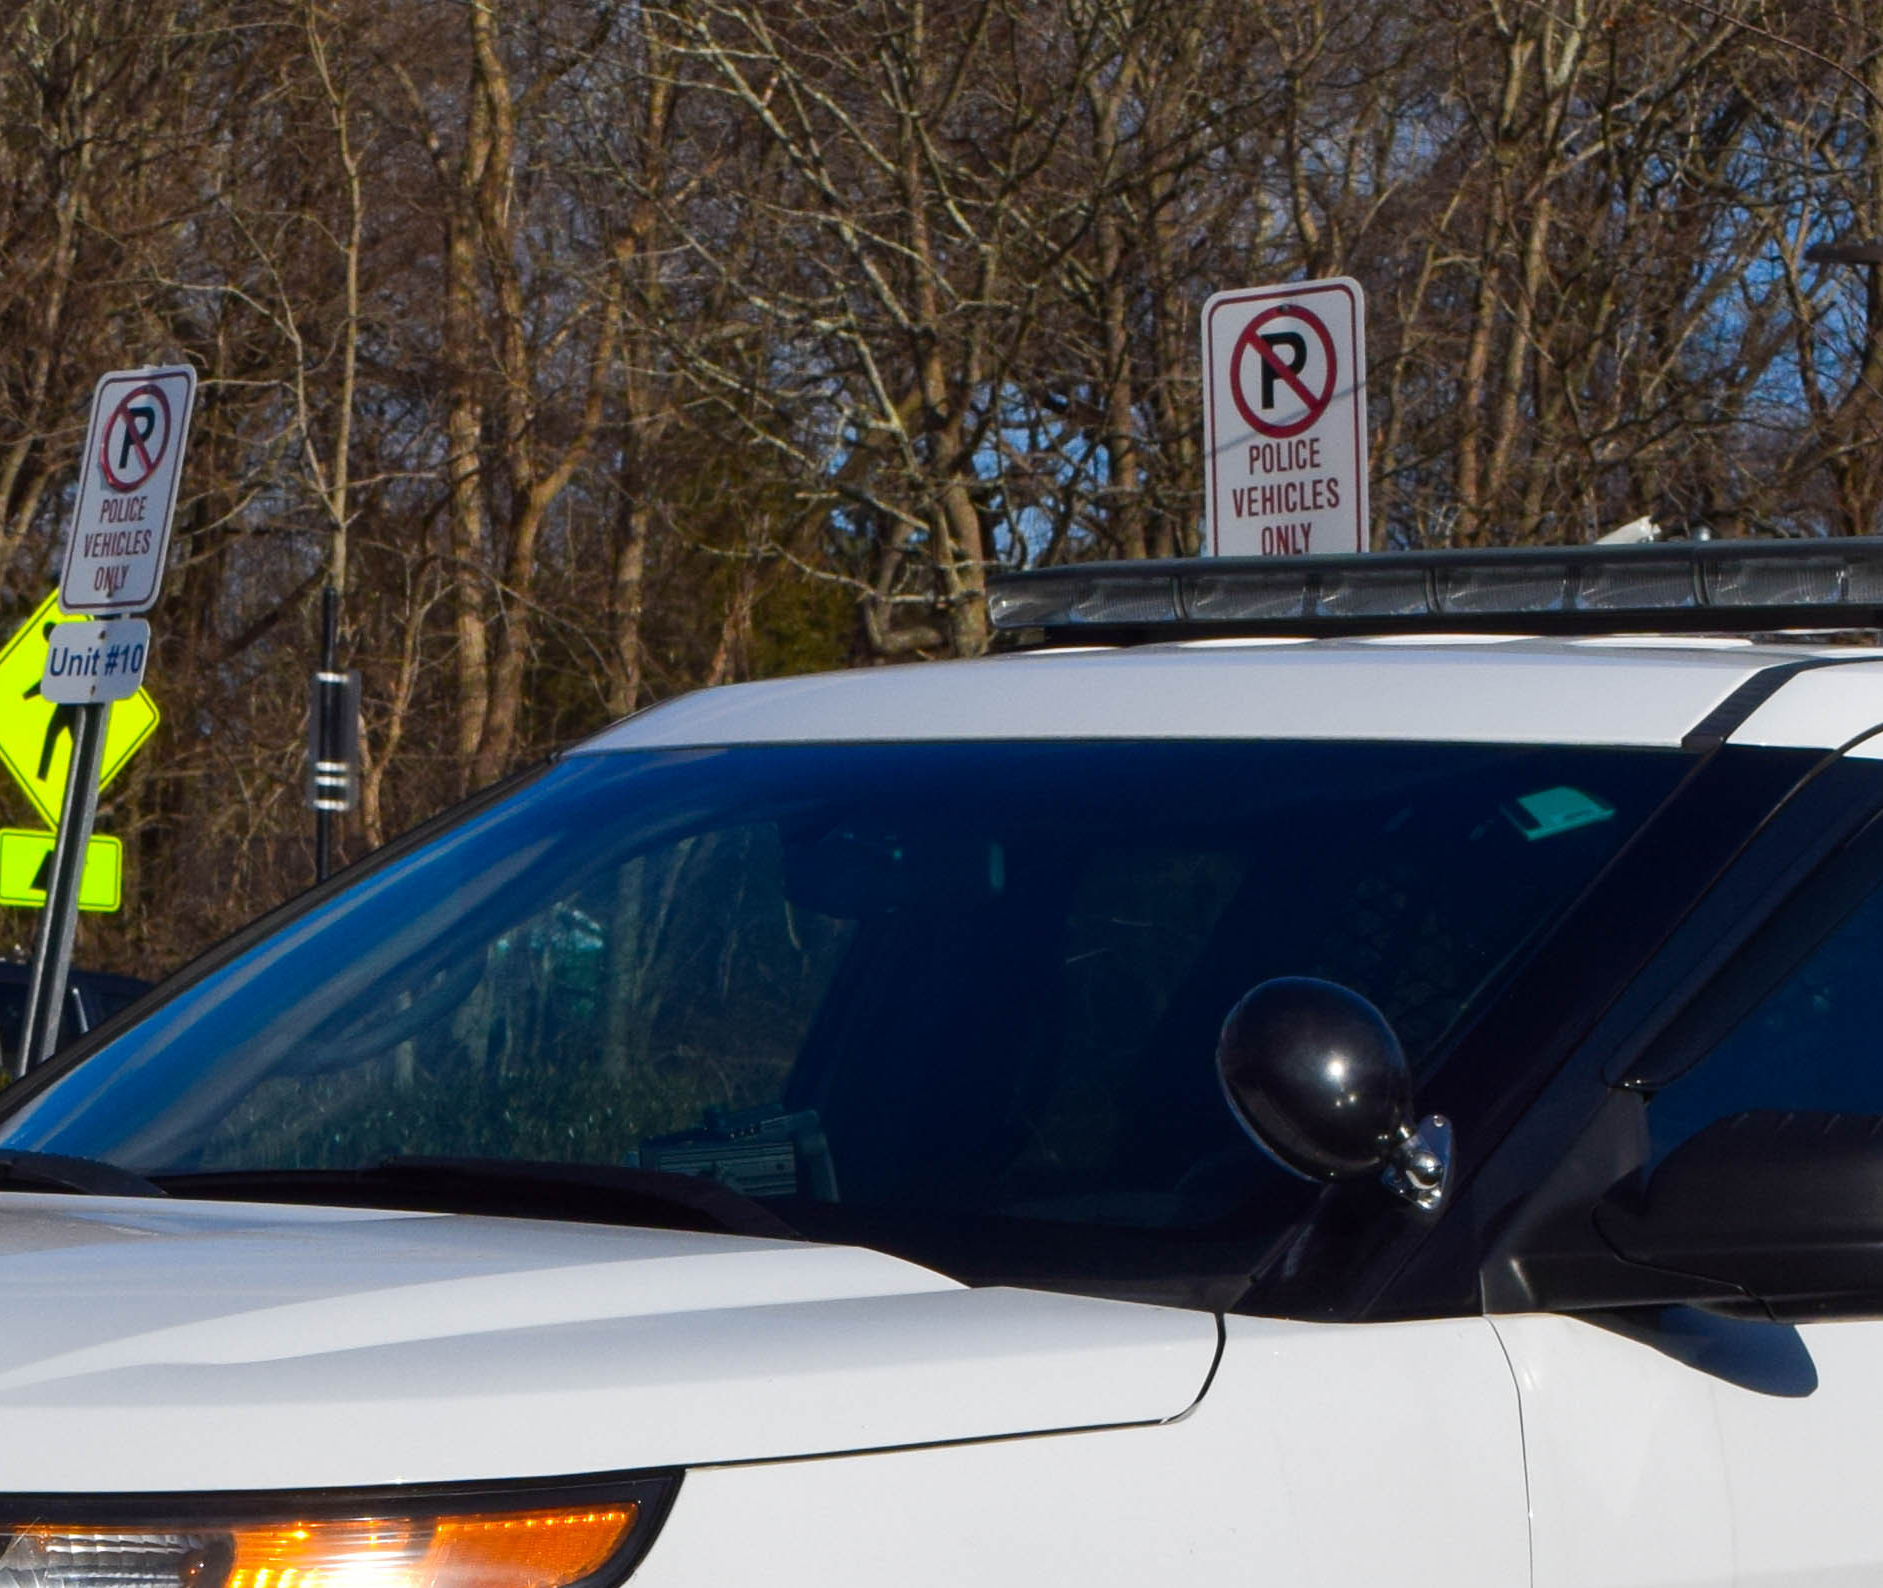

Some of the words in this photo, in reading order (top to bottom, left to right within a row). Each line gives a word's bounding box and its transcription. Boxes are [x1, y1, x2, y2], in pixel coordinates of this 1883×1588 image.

[1249, 438, 1321, 475] POLICE
[99, 496, 146, 523] POLICE
[1232, 477, 1340, 518] VEHICLES
[83, 529, 152, 558] VEHICLES
[1261, 522, 1313, 556] ONLY
[94, 562, 131, 592] ONLY
[49, 646, 99, 677] Unit
[103, 643, 144, 675] #10
